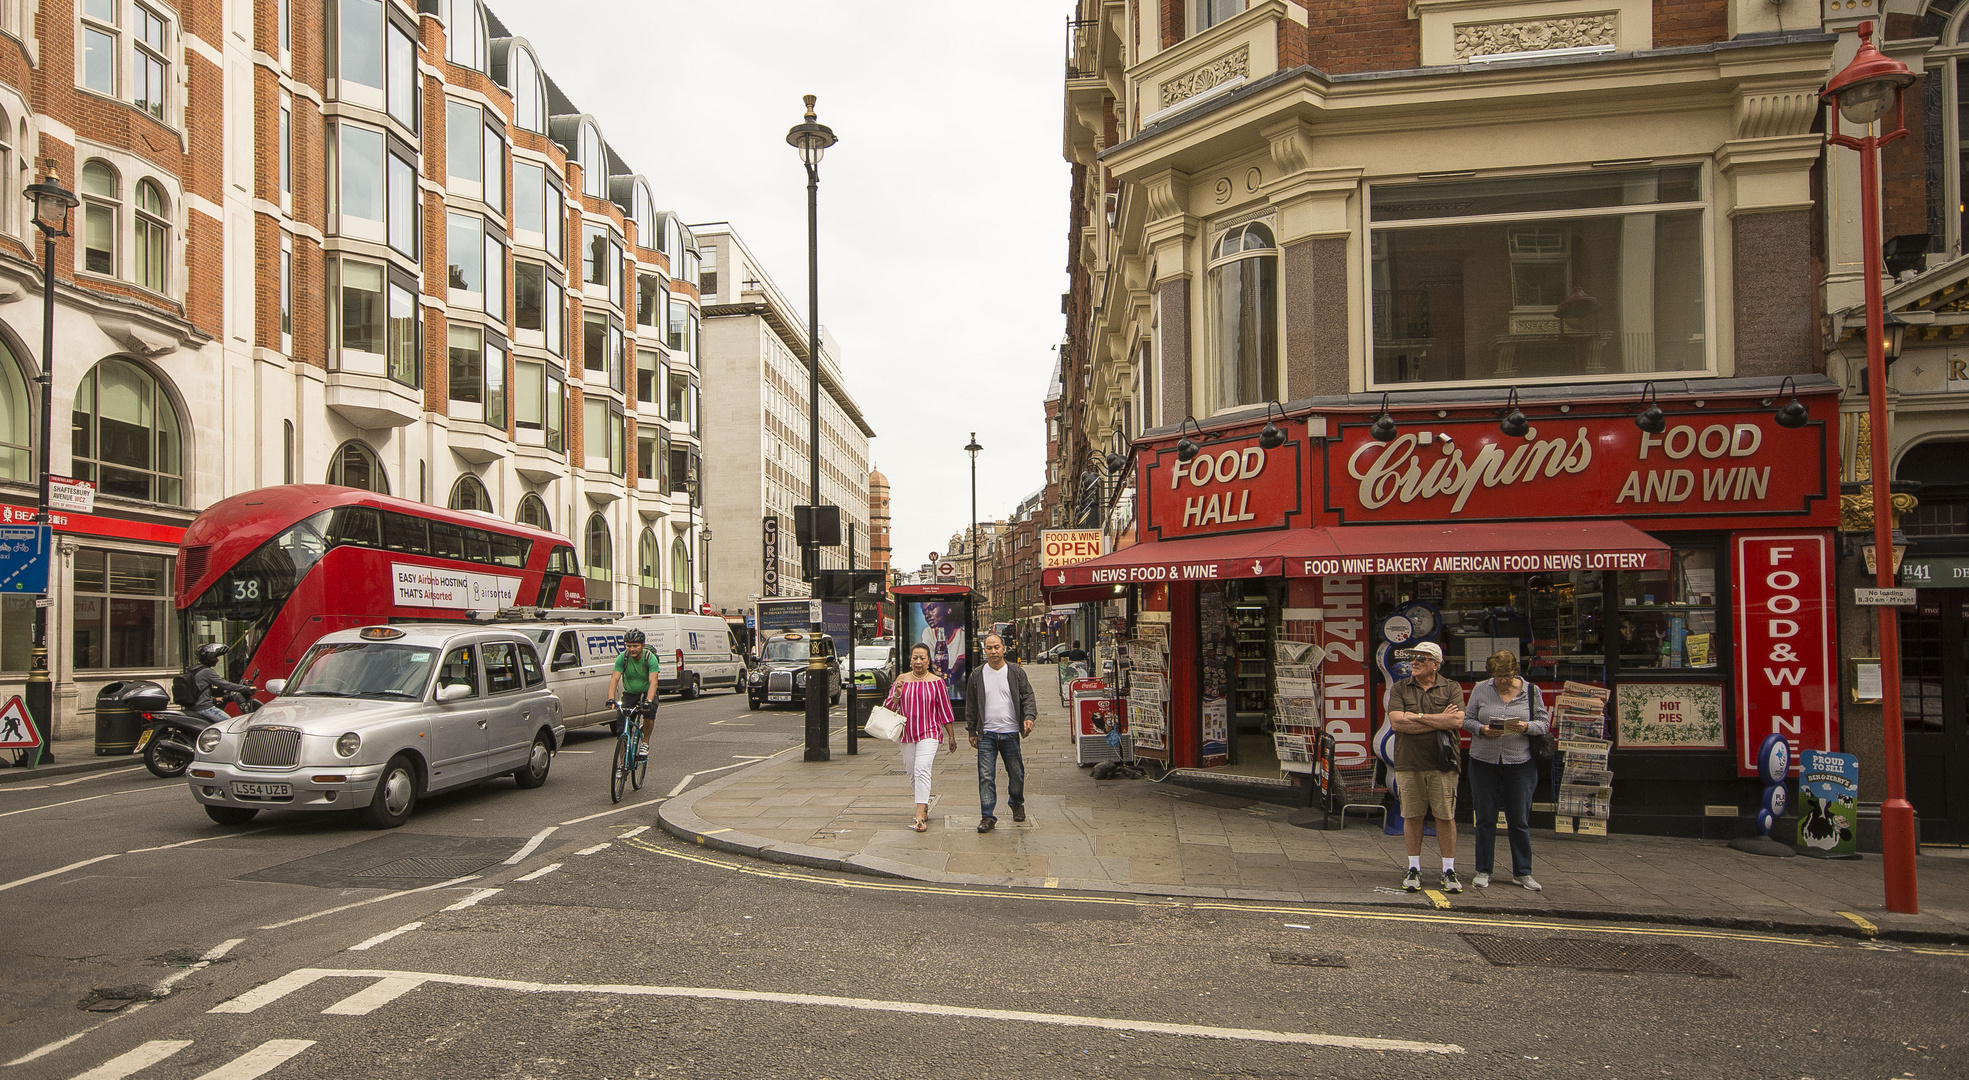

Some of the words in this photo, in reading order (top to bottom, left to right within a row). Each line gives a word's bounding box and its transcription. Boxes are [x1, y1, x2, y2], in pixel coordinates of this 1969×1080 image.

[1214, 166, 1262, 205] 90
[1639, 423, 1763, 460] FOOD
[1171, 446, 1265, 489] FOOD
[1347, 426, 1592, 514] Crispins
[53, 485, 90, 497] SHAFTESBURY
[1615, 468, 1695, 504] AND
[1702, 466, 1771, 501] WIN
[52, 492, 73, 502] AVENUE
[74, 495, 86, 504] WC2
[1182, 489, 1255, 528] HALL
[1045, 533, 1069, 542] FOOD
[1070, 532, 1077, 541] &
[1078, 532, 1100, 541] WINE
[1046, 541, 1100, 557] OPEN
[764, 519, 777, 596] CURZON
[1048, 558, 1060, 567] 24
[1062, 557, 1098, 567] HOU
[1304, 559, 1339, 576] FOOD
[1342, 558, 1374, 574] WINE
[1376, 557, 1429, 573] BAKERY
[1433, 556, 1500, 571] AMERICAN
[1503, 555, 1540, 571] FOOD
[1543, 554, 1582, 570] NEWS
[1586, 553, 1647, 569] LOTTERY
[398, 572, 417, 584] EASY
[417, 574, 440, 586] Airbnb
[440, 577, 467, 588] HOSTING
[1091, 568, 1127, 583] NEWS
[1130, 566, 1166, 581] FOOD
[1169, 566, 1179, 579] &
[1182, 564, 1218, 579] WINE
[233, 579, 259, 599] 38
[400, 587, 423, 599] THAT'S
[424, 589, 452, 601] Airsorted
[481, 587, 511, 599] airsorted
[587, 635, 626, 655] FPRS
[1562, 699, 1585, 707] FINANCIAL
[1659, 701, 1681, 711] HOT
[1325, 674, 1368, 766] OPEN
[1658, 713, 1683, 723] PIES
[1812, 755, 1844, 766] PROUD
[1825, 764, 1844, 773] SELL
[235, 782, 264, 795] LS54
[265, 783, 288, 796] UZB
